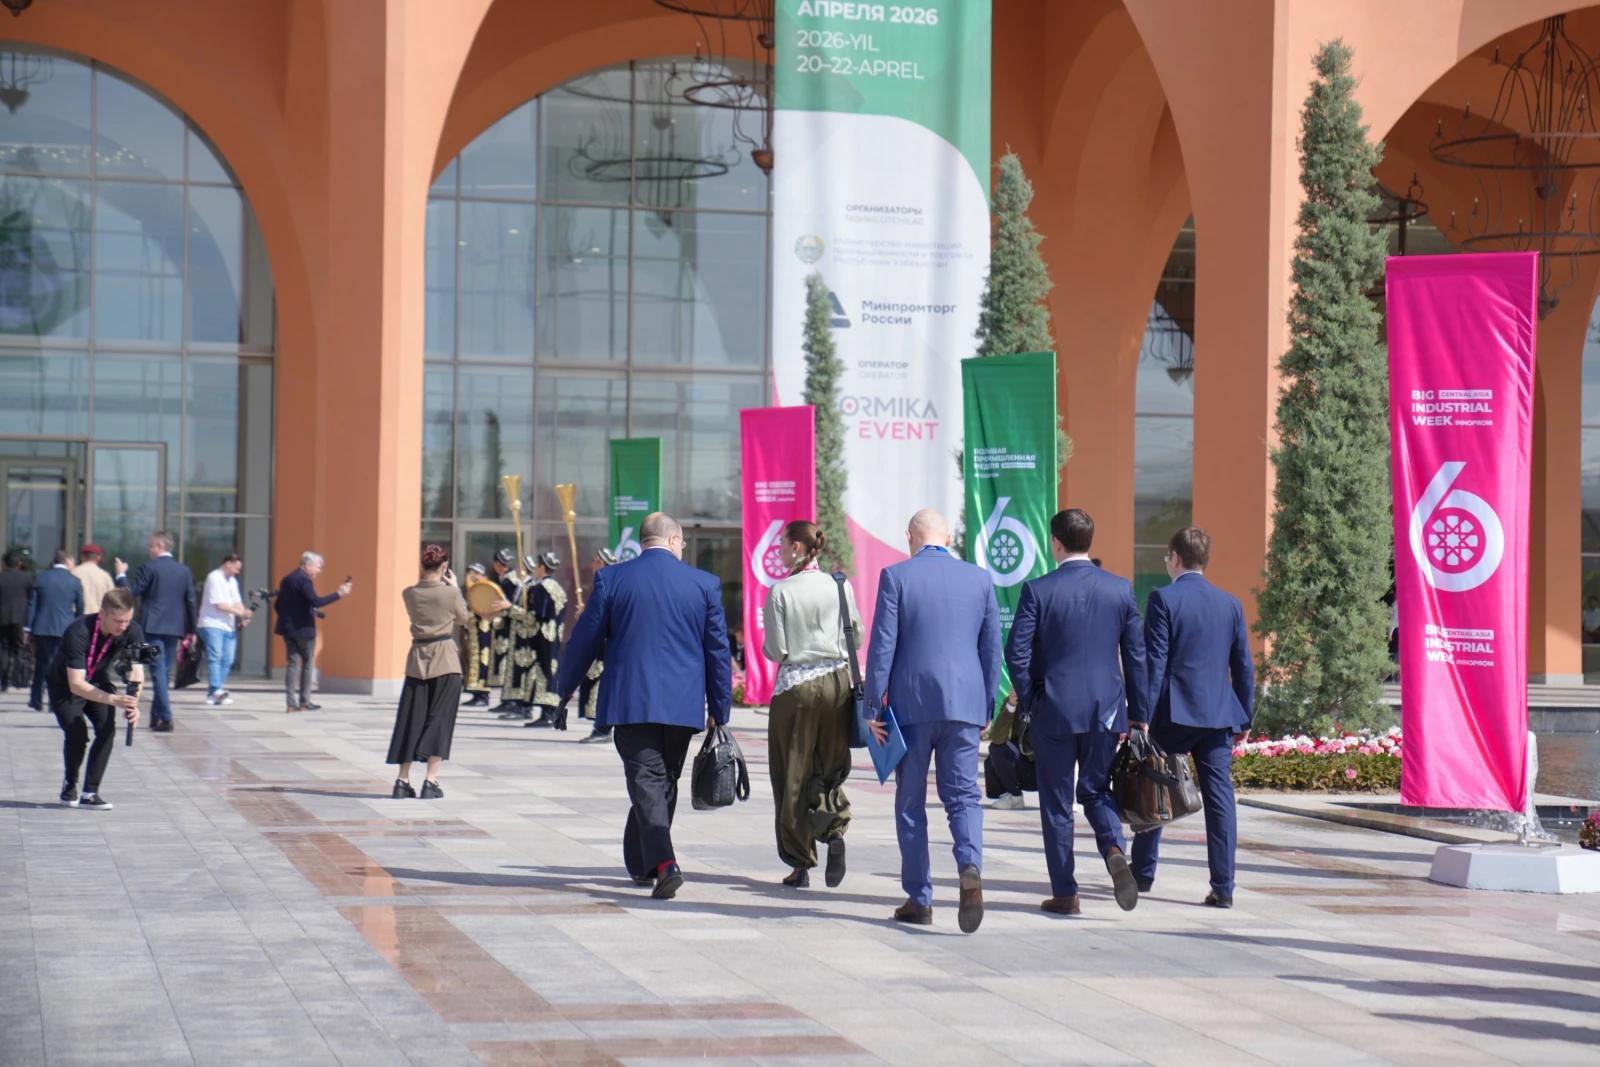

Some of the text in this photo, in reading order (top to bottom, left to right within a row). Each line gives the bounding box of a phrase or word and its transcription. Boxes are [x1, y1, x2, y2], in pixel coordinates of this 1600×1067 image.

[797, 0, 939, 25] АПРЕЛЯ 2026
[797, 30, 880, 52] 2026-YIL
[846, 204, 923, 215] ОРГАНИЗАТОРЫ
[862, 300, 957, 314] Минпромторг
[862, 313, 912, 325] России
[858, 360, 909, 369] ОПЕРАТОР
[1411, 389, 1435, 401] BIG
[839, 396, 939, 419] ORMIKA
[1411, 402, 1492, 413] INDUSTRIAL
[1412, 415, 1493, 427] WEEK INNOPROM
[859, 421, 940, 441] EVENT
[1456, 659, 1494, 667] INNOPROM
